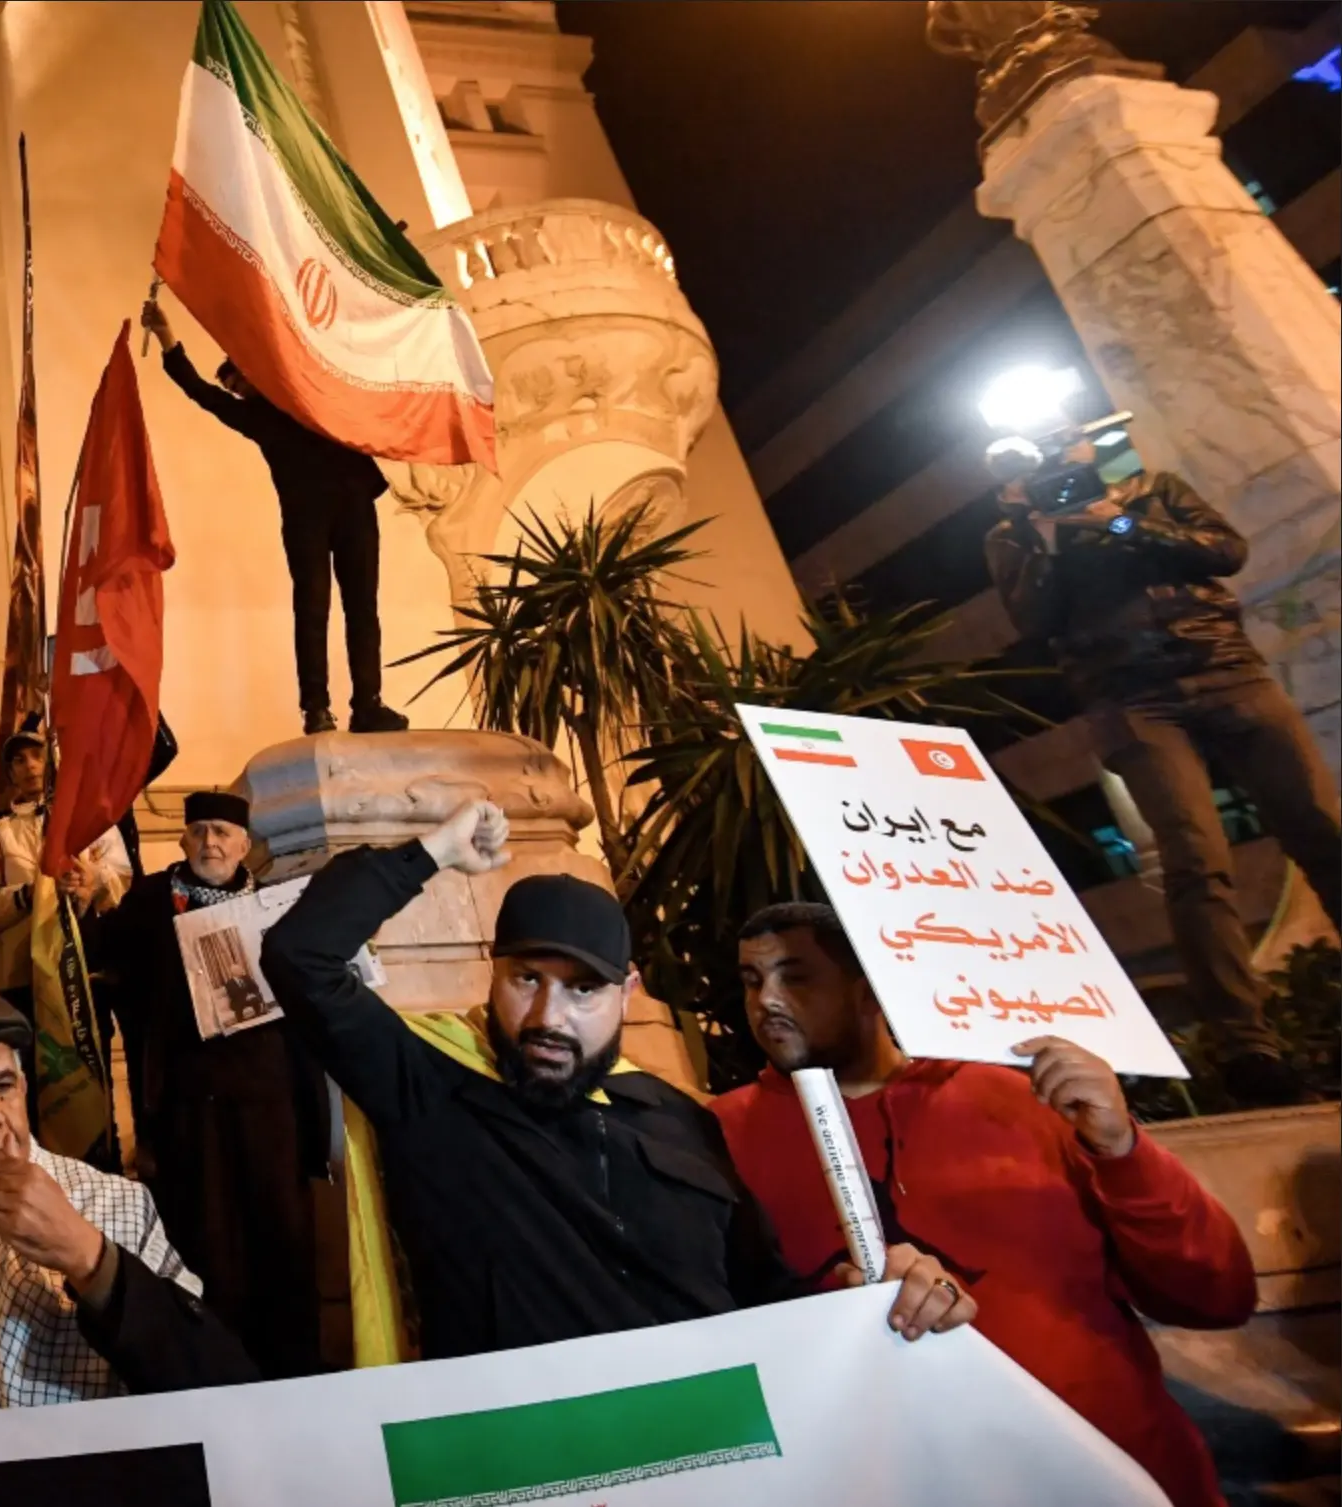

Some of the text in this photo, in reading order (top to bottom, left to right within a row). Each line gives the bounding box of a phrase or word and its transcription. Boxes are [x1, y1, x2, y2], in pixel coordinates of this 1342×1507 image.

[841, 799, 988, 852] مع إيران
[841, 849, 1056, 896] ضد العدوان
[879, 911, 1090, 962] الأمريكي
[933, 974, 1117, 1030] الصهيوني
